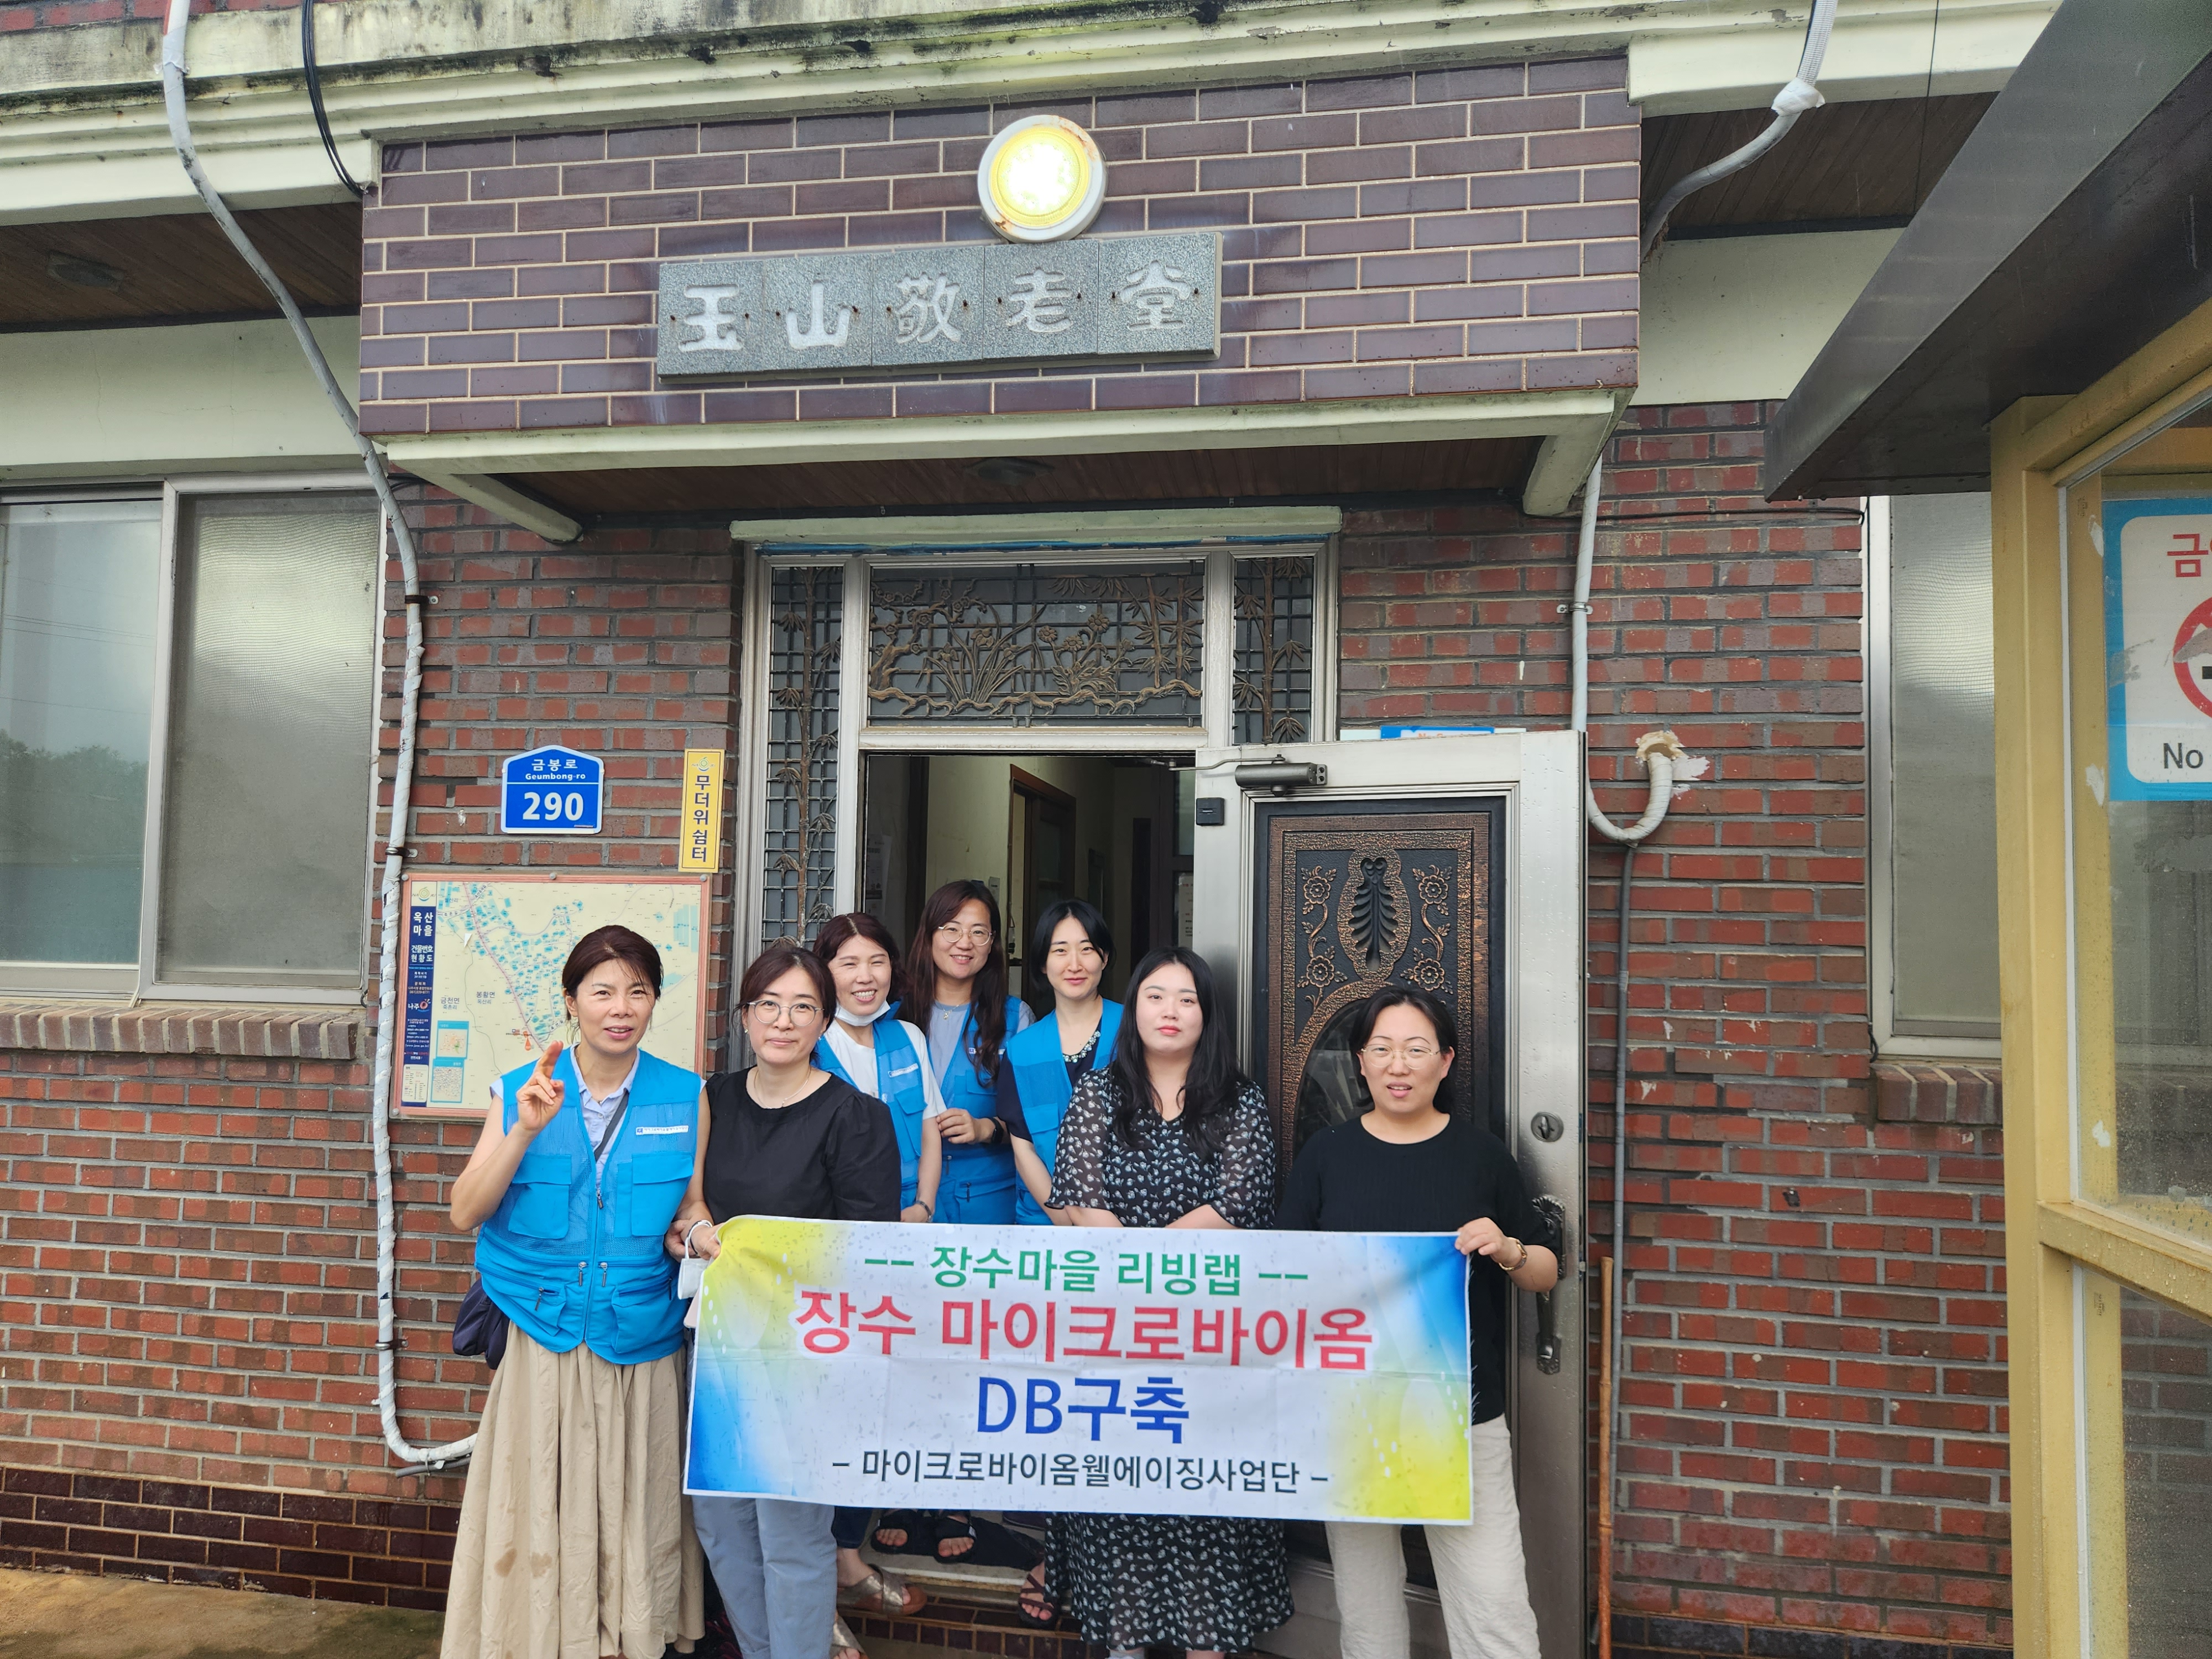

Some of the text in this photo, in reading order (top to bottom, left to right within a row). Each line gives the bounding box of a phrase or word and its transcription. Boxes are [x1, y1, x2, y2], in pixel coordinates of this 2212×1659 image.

[531, 759, 578, 772] 금봉로
[2163, 743, 2203, 769] No
[523, 792, 584, 821] 290
[692, 775, 711, 863] 무더위쉼터
[413, 925, 432, 936] 마을
[414, 912, 433, 923] 옥산
[411, 945, 433, 953] 건물번호
[411, 954, 432, 963] 현황도
[930, 1246, 1100, 1293] 장수마을
[1118, 1251, 1241, 1296] 리빙랩
[796, 1291, 1373, 1370] 장수 마이크로바이옴
[977, 1376, 1190, 1444] DB구축
[862, 1450, 1300, 1494] 마이크로바이옴웰에이징사업단
